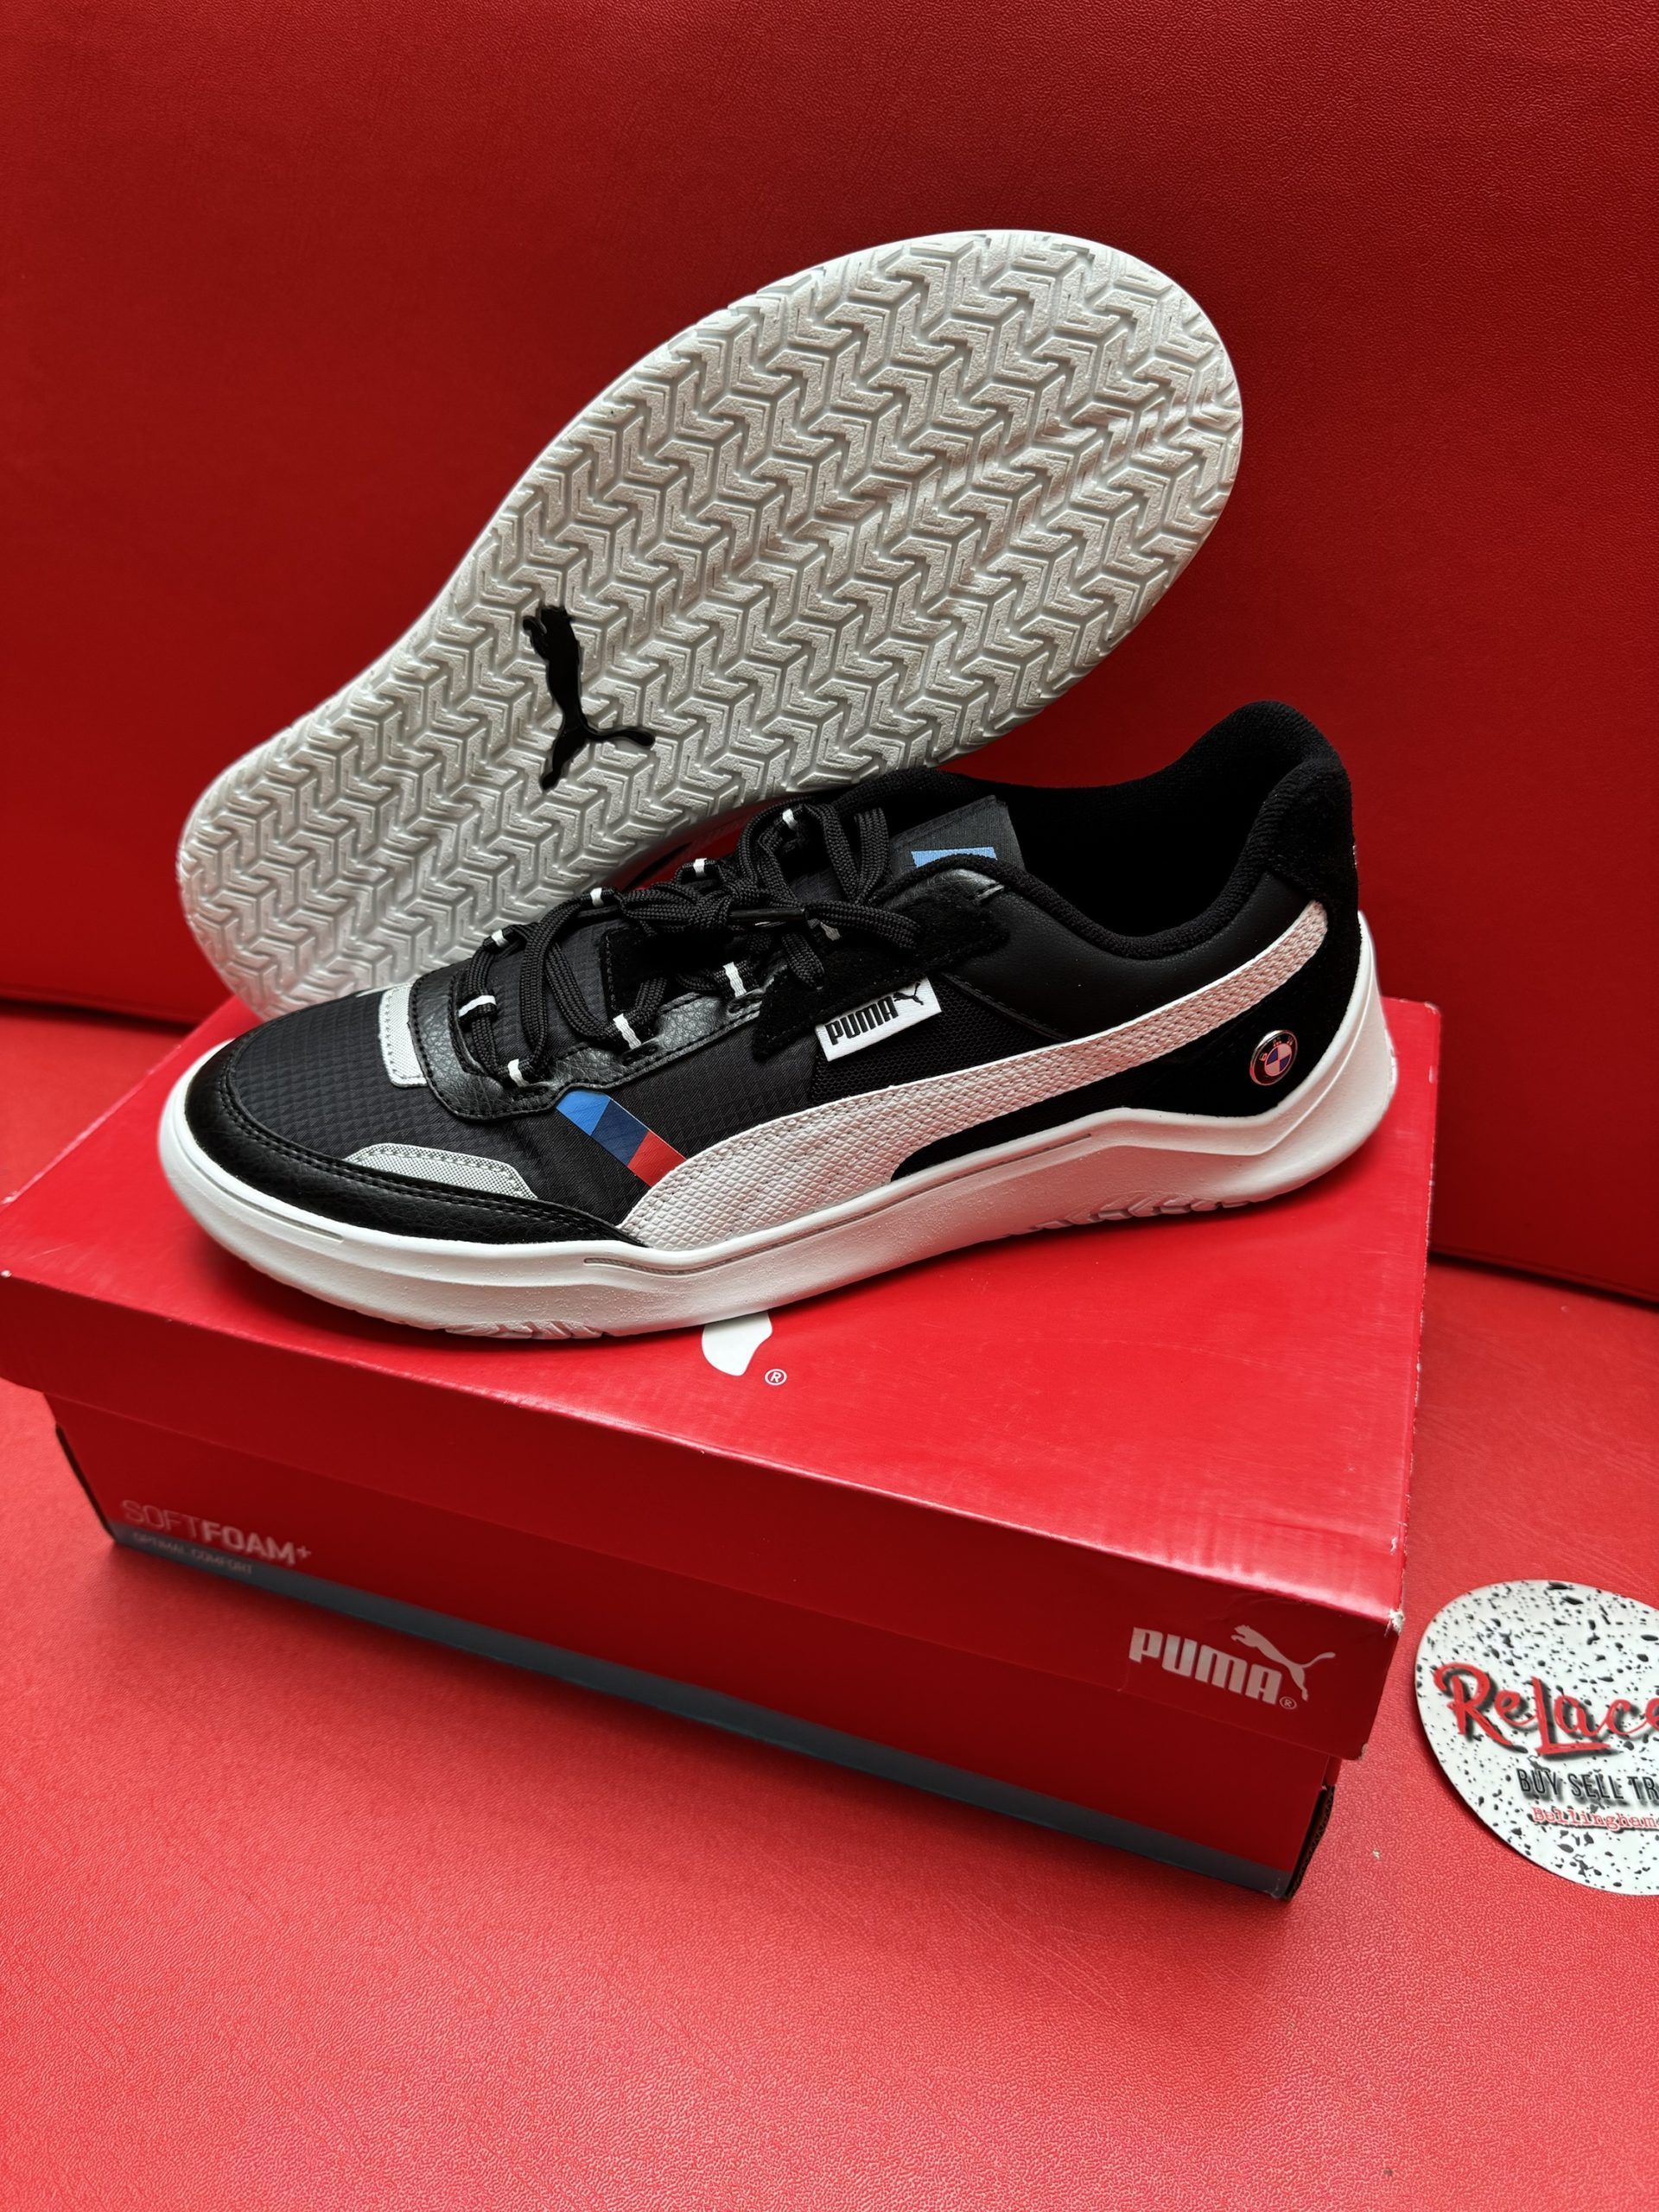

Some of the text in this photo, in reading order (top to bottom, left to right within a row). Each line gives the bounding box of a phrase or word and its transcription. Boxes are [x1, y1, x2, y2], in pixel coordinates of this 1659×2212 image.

[824, 995, 899, 1046] PUMA
[1516, 1768, 1558, 1796] BUY
[1567, 1773, 1624, 1800] SELL
